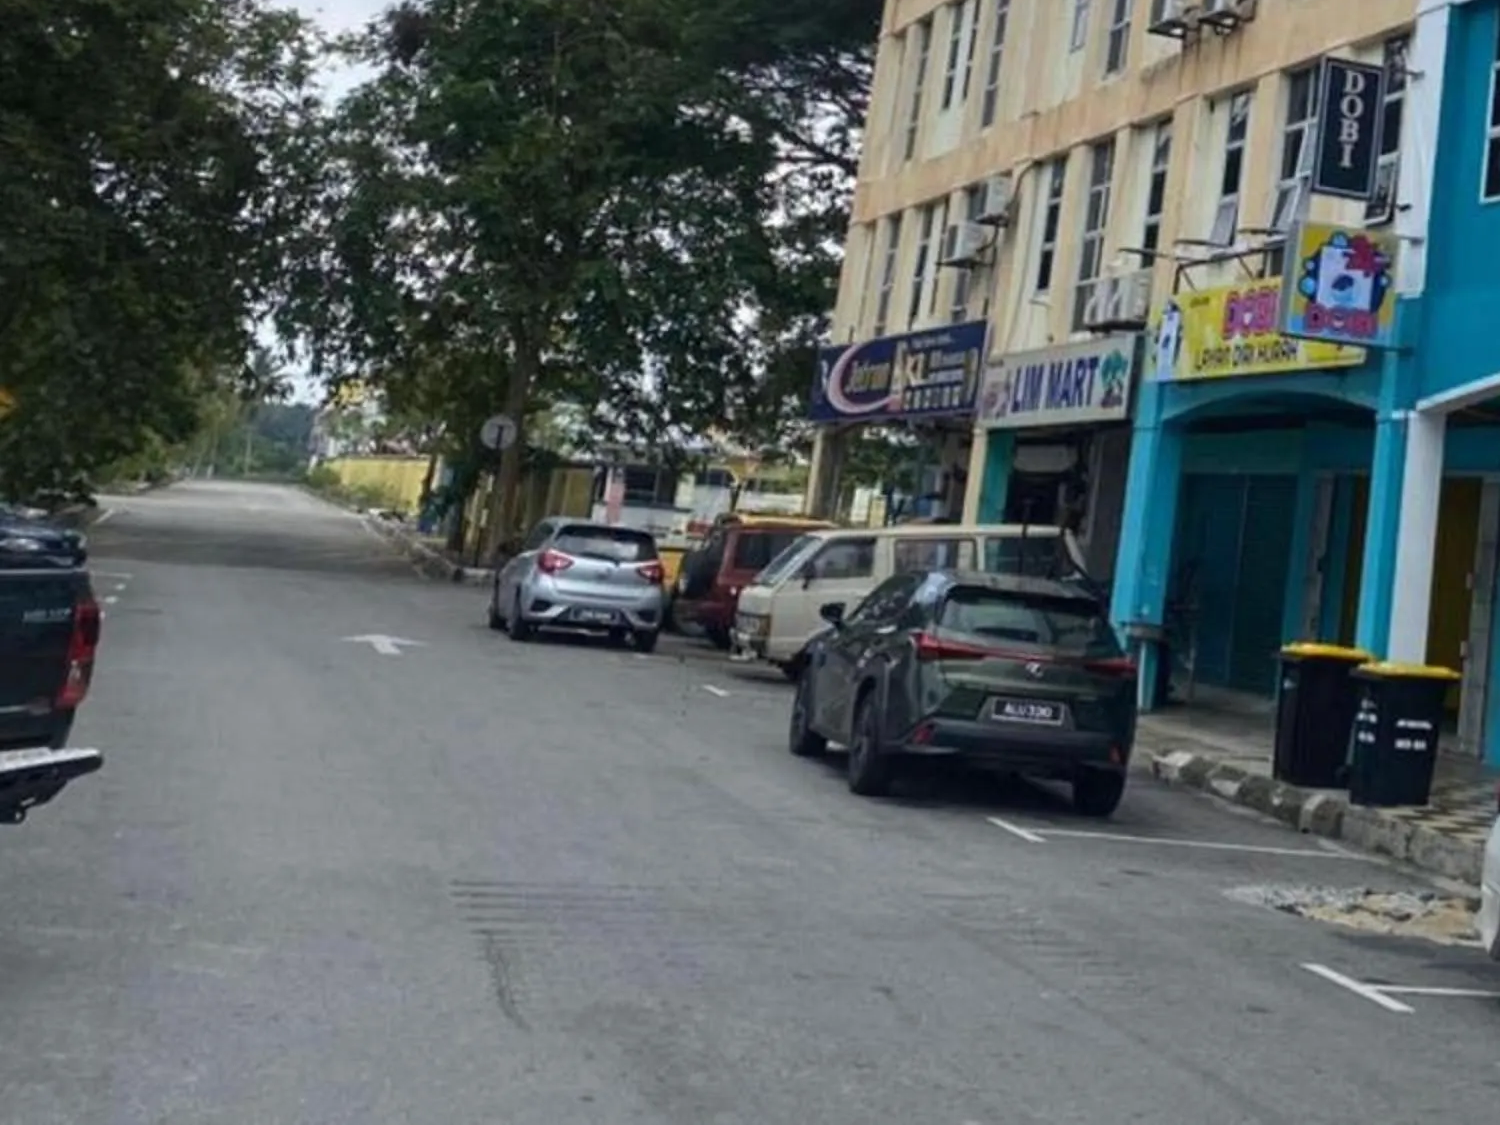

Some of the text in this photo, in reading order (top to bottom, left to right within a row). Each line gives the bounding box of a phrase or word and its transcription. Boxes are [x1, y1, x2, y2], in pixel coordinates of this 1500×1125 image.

[1339, 71, 1366, 169] DOBI
[1011, 365, 1045, 413] LIM
[1047, 355, 1099, 408] MART
